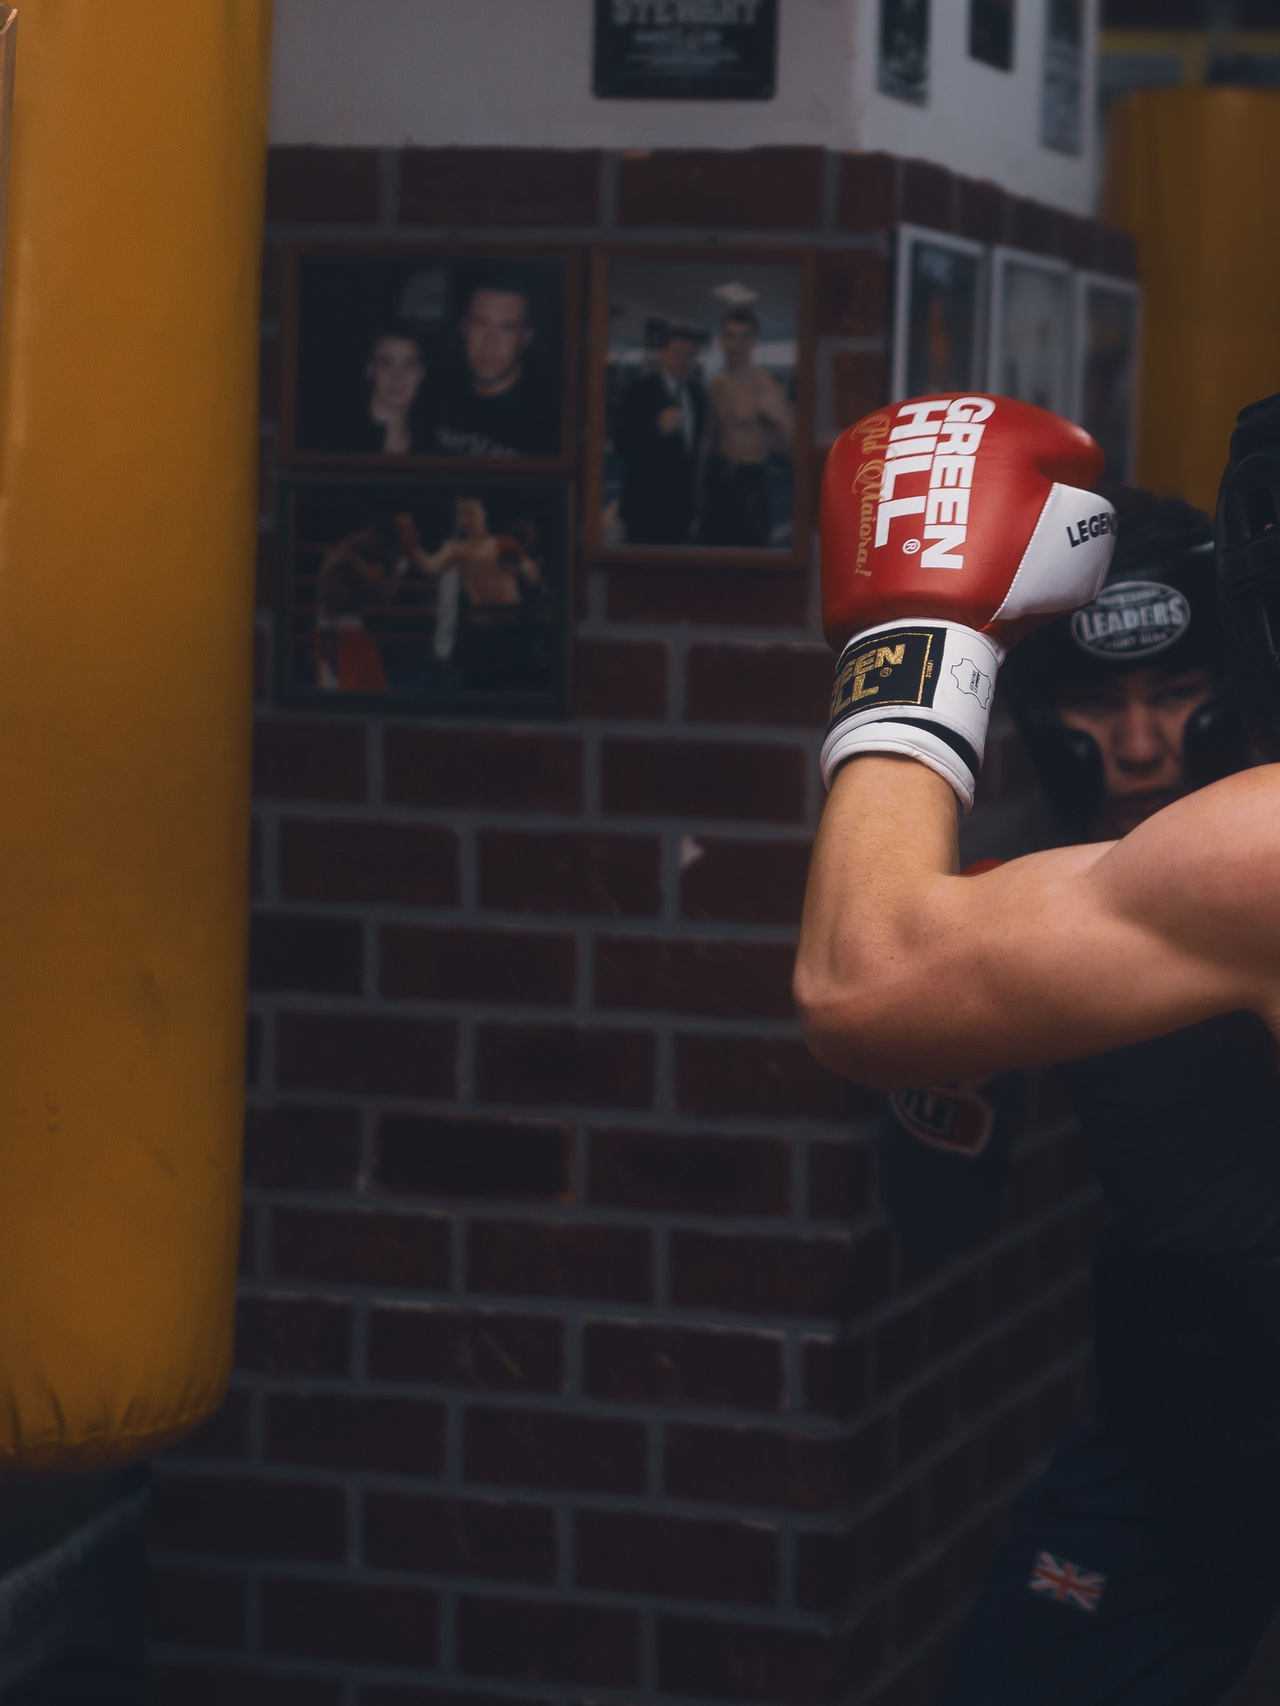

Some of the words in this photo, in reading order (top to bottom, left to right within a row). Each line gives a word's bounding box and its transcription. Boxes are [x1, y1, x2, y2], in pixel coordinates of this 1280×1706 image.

[873, 399, 953, 549] HILL
[920, 396, 997, 570] GREEN
[1081, 596, 1183, 642] LEADERS
